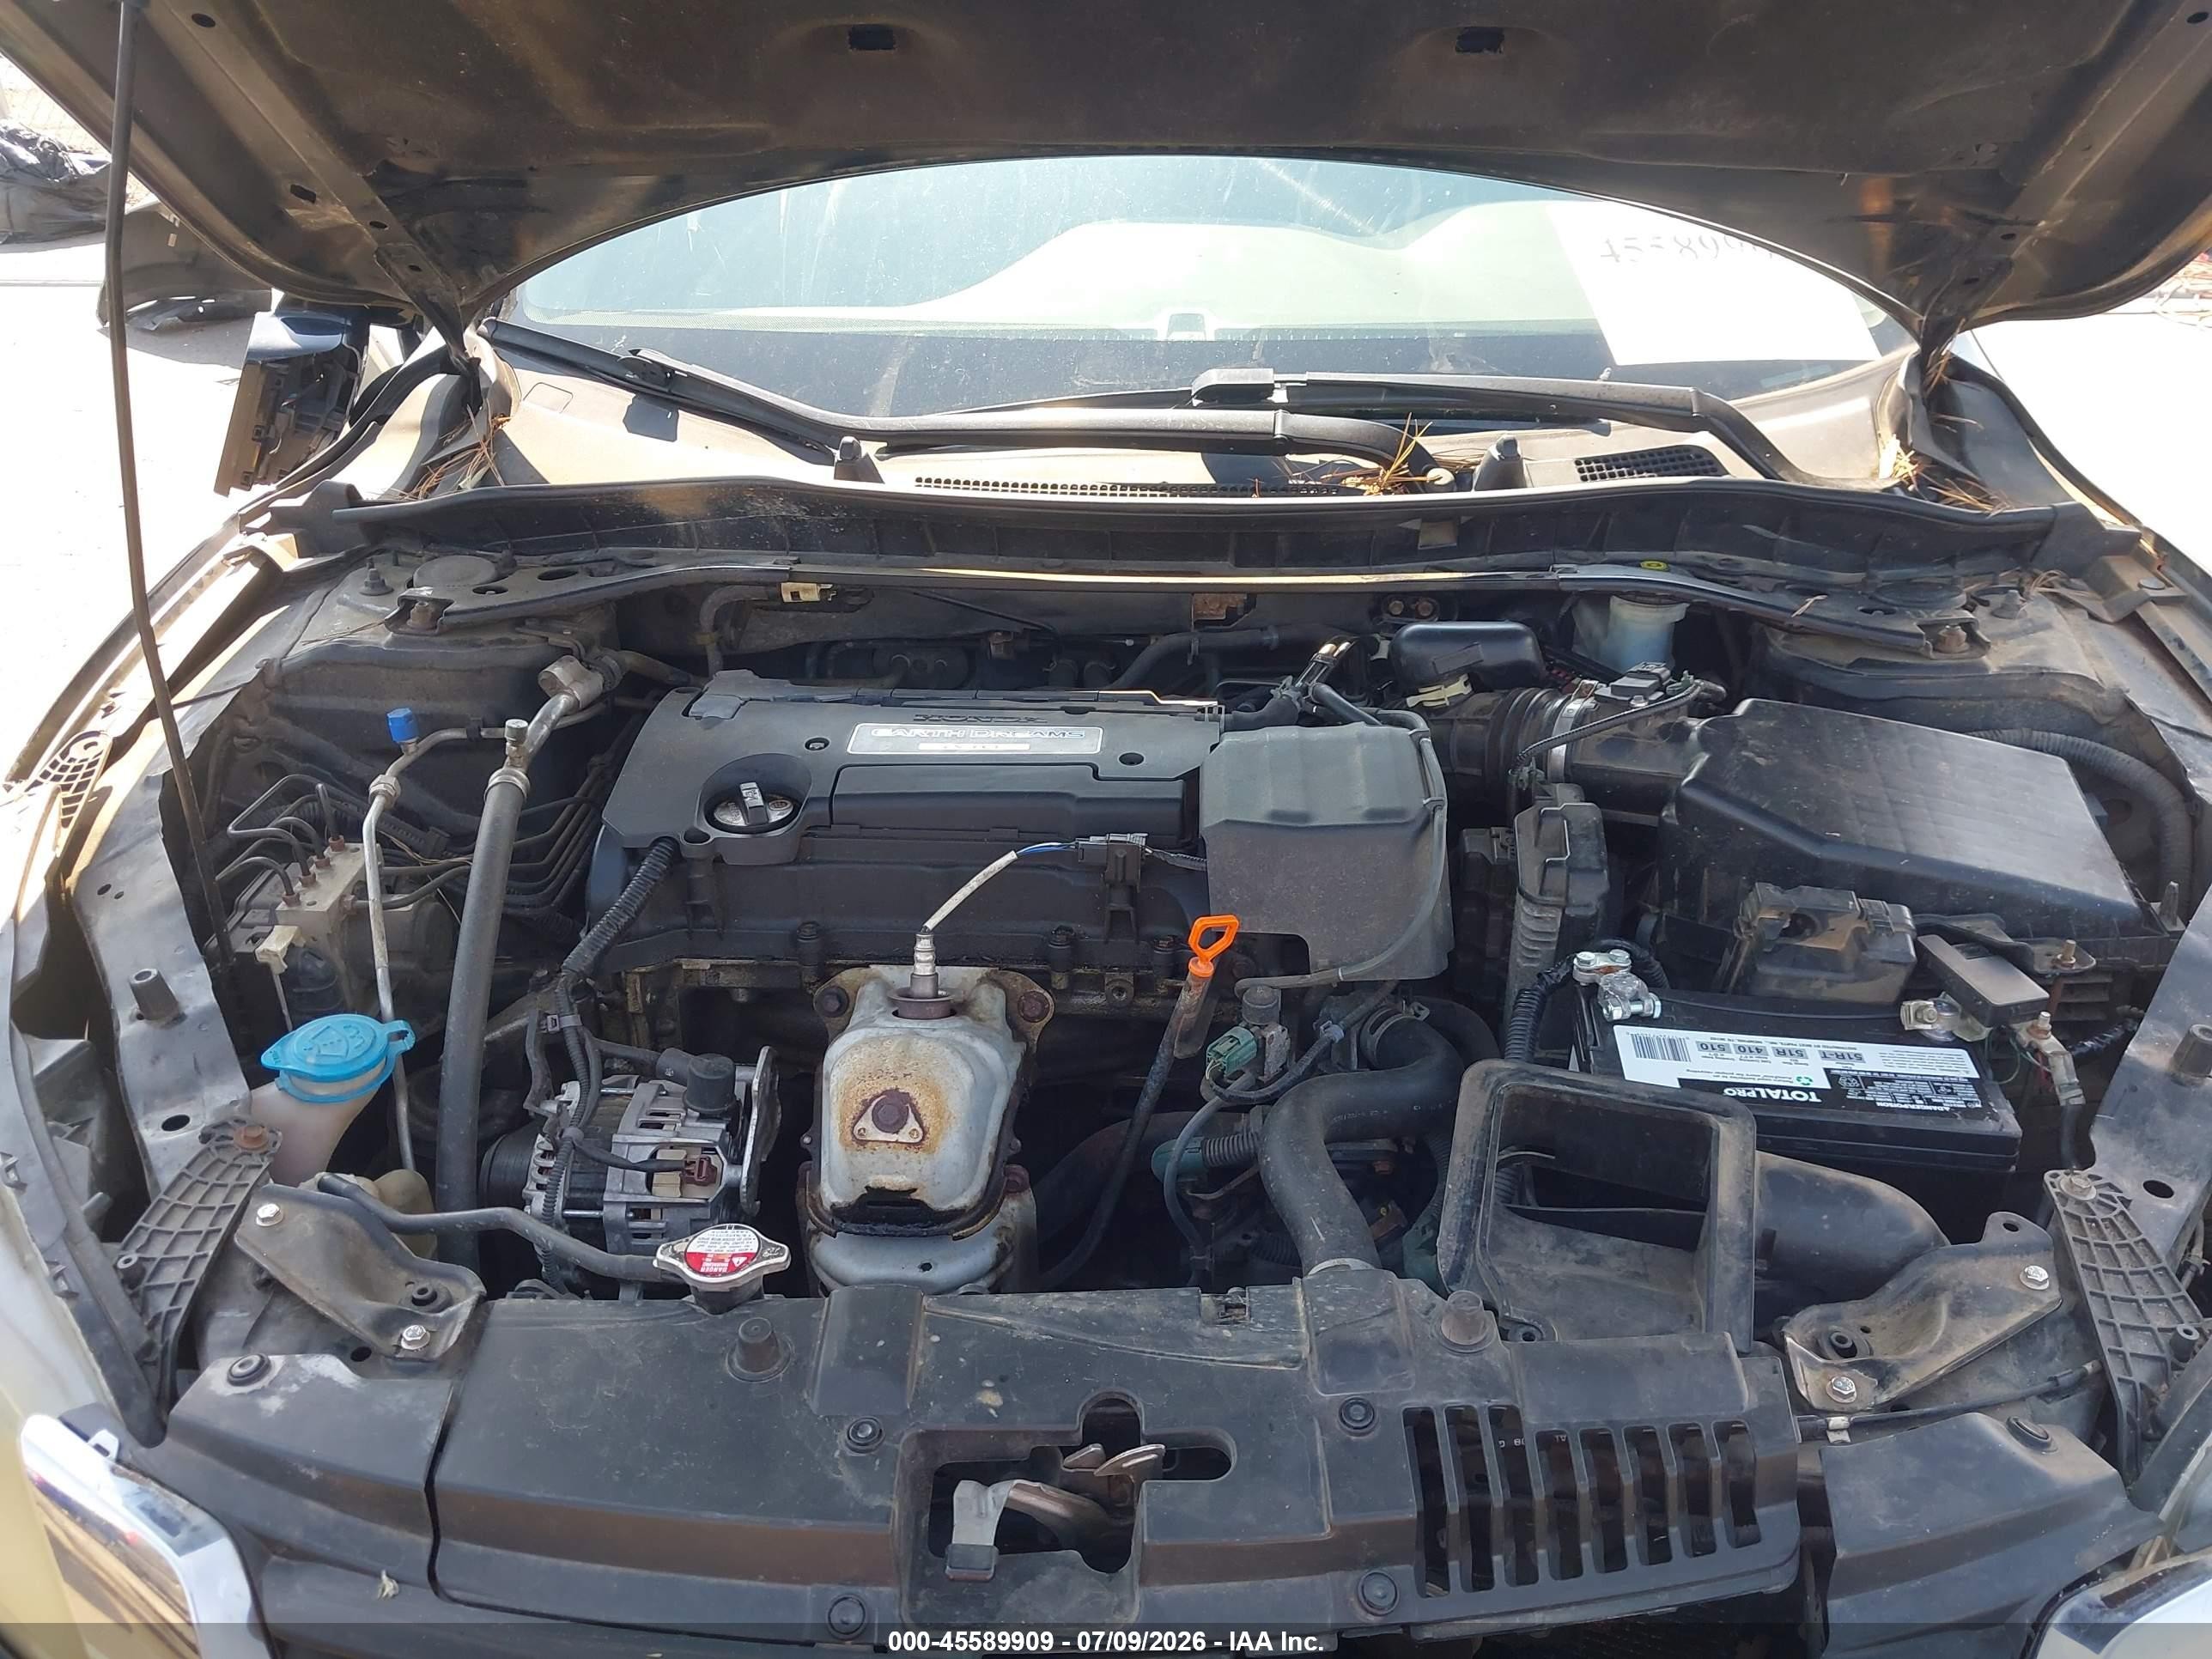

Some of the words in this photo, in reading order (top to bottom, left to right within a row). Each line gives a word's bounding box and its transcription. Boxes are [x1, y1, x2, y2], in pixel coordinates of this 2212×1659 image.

[1700, 1042, 1725, 1052] 510
[1737, 1044, 1763, 1054] 410
[1775, 1047, 1804, 1057] 51R
[1820, 1050, 1863, 1061] 51R-T
[1723, 1087, 1822, 1103] TOTALPRO
